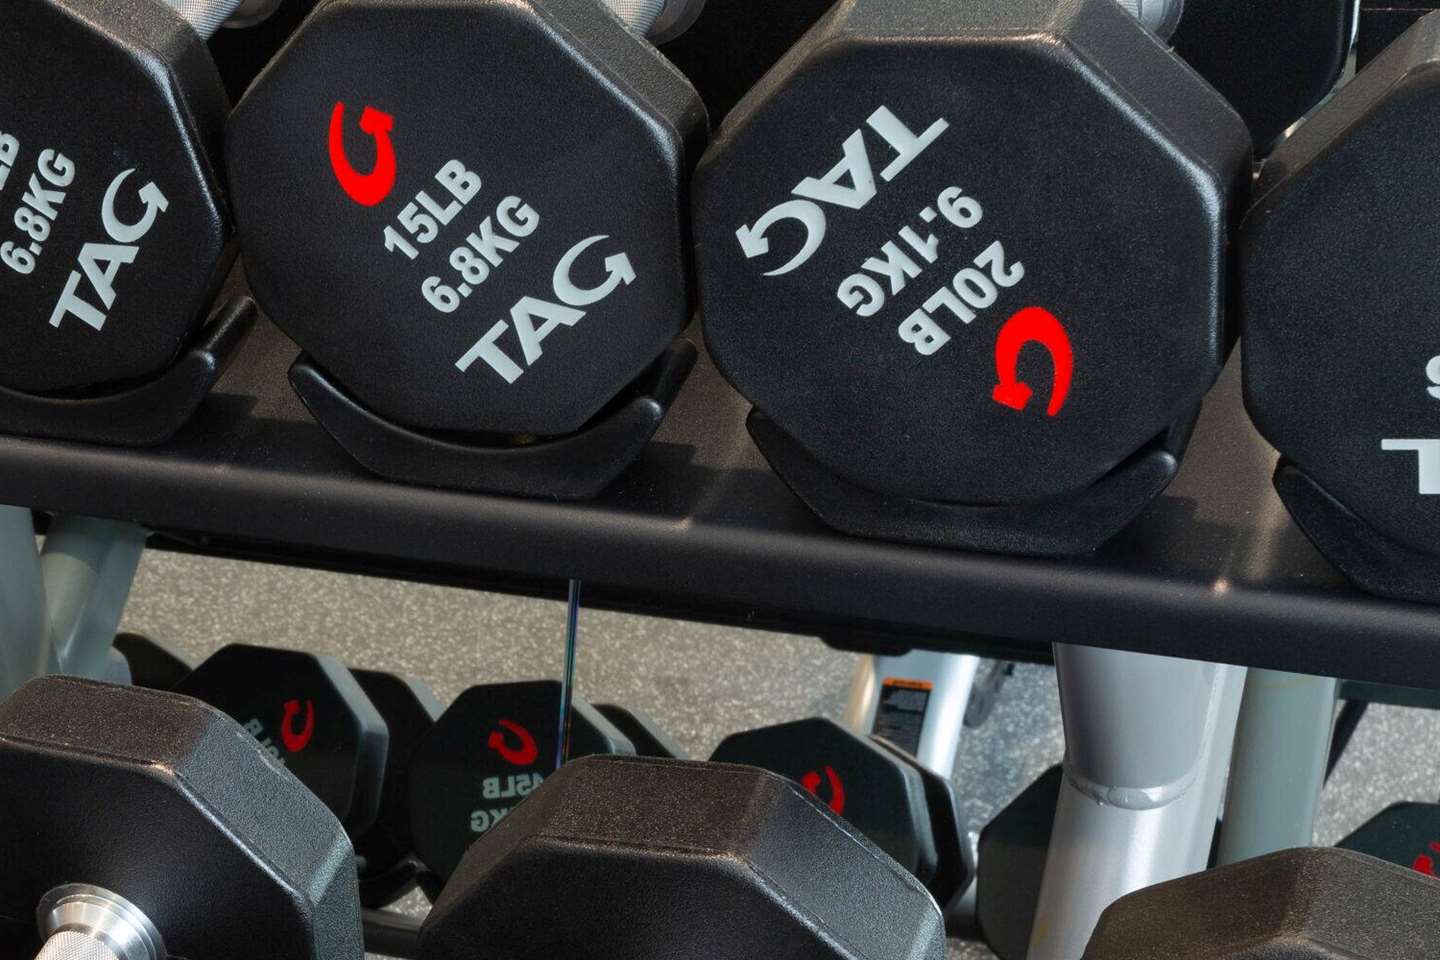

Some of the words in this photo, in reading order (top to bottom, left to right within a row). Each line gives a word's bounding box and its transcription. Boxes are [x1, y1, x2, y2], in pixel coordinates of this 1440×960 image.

[0, 148, 75, 275] 6.8KG
[48, 167, 169, 331] TAG
[383, 159, 482, 260] 15LB
[421, 195, 540, 313] 6.8KG
[735, 105, 949, 276] TAG
[836, 186, 983, 317] 9.1KG
[454, 235, 637, 384] TAG
[898, 240, 1025, 356] 20LB
